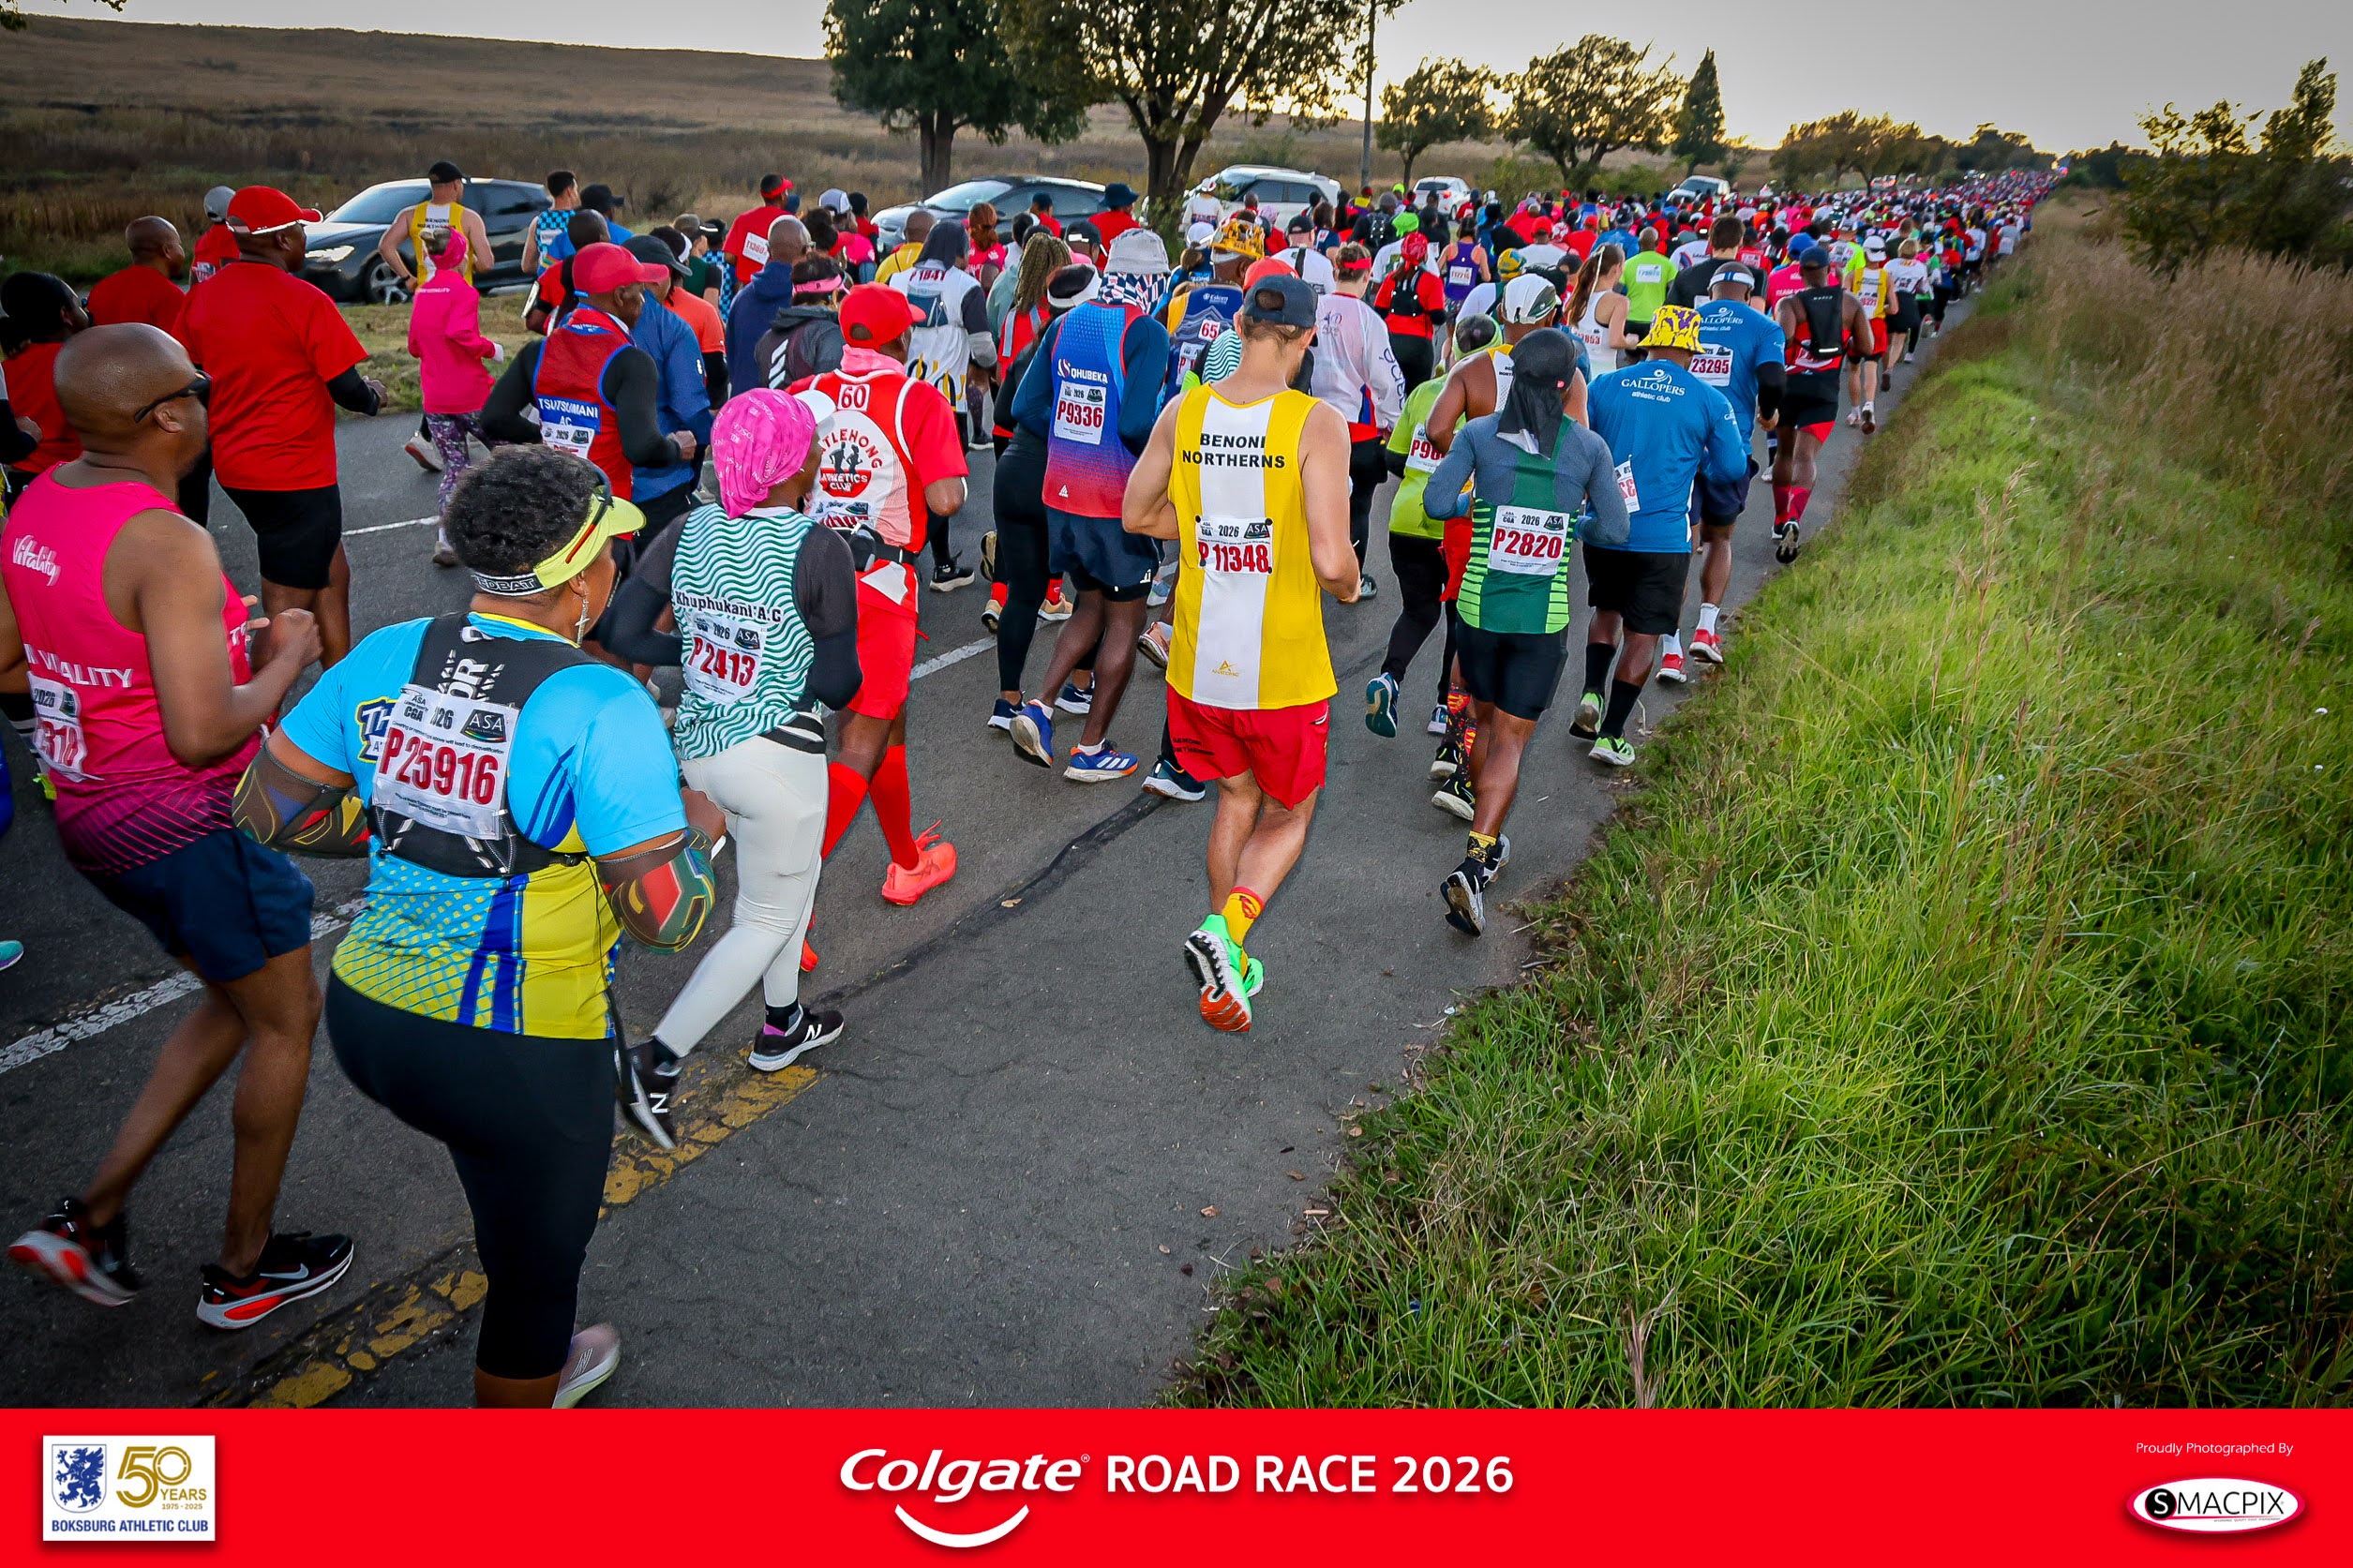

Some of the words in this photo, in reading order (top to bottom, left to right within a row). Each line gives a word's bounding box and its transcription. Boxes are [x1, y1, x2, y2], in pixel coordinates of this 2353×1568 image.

[1201, 322, 1218, 338] 65
[1691, 358, 1730, 374] 23295
[1071, 368, 1108, 383] QHUBEKA
[1621, 379, 1686, 396] GALLOPERS
[842, 385, 867, 409] 60
[1632, 390, 1656, 400] athletic
[1656, 394, 1671, 403] club
[538, 398, 598, 418] TSUTSUMANI
[1057, 400, 1102, 427] P9336
[559, 416, 572, 426] AC
[1200, 433, 1266, 448] BENONI
[1182, 450, 1285, 469] NORTHERNS
[1521, 515, 1540, 526] 2026
[1548, 516, 1564, 525] ASA
[1219, 525, 1239, 537] 2026
[1492, 528, 1562, 559] P2820
[12, 534, 61, 587] Vitality
[675, 591, 752, 618] Khuphukani
[757, 605, 781, 622] A.C
[738, 630, 758, 643] ASA
[687, 636, 756, 687] P2413
[403, 706, 424, 722] CGA
[470, 713, 502, 731] ASA
[379, 726, 499, 805] P25916
